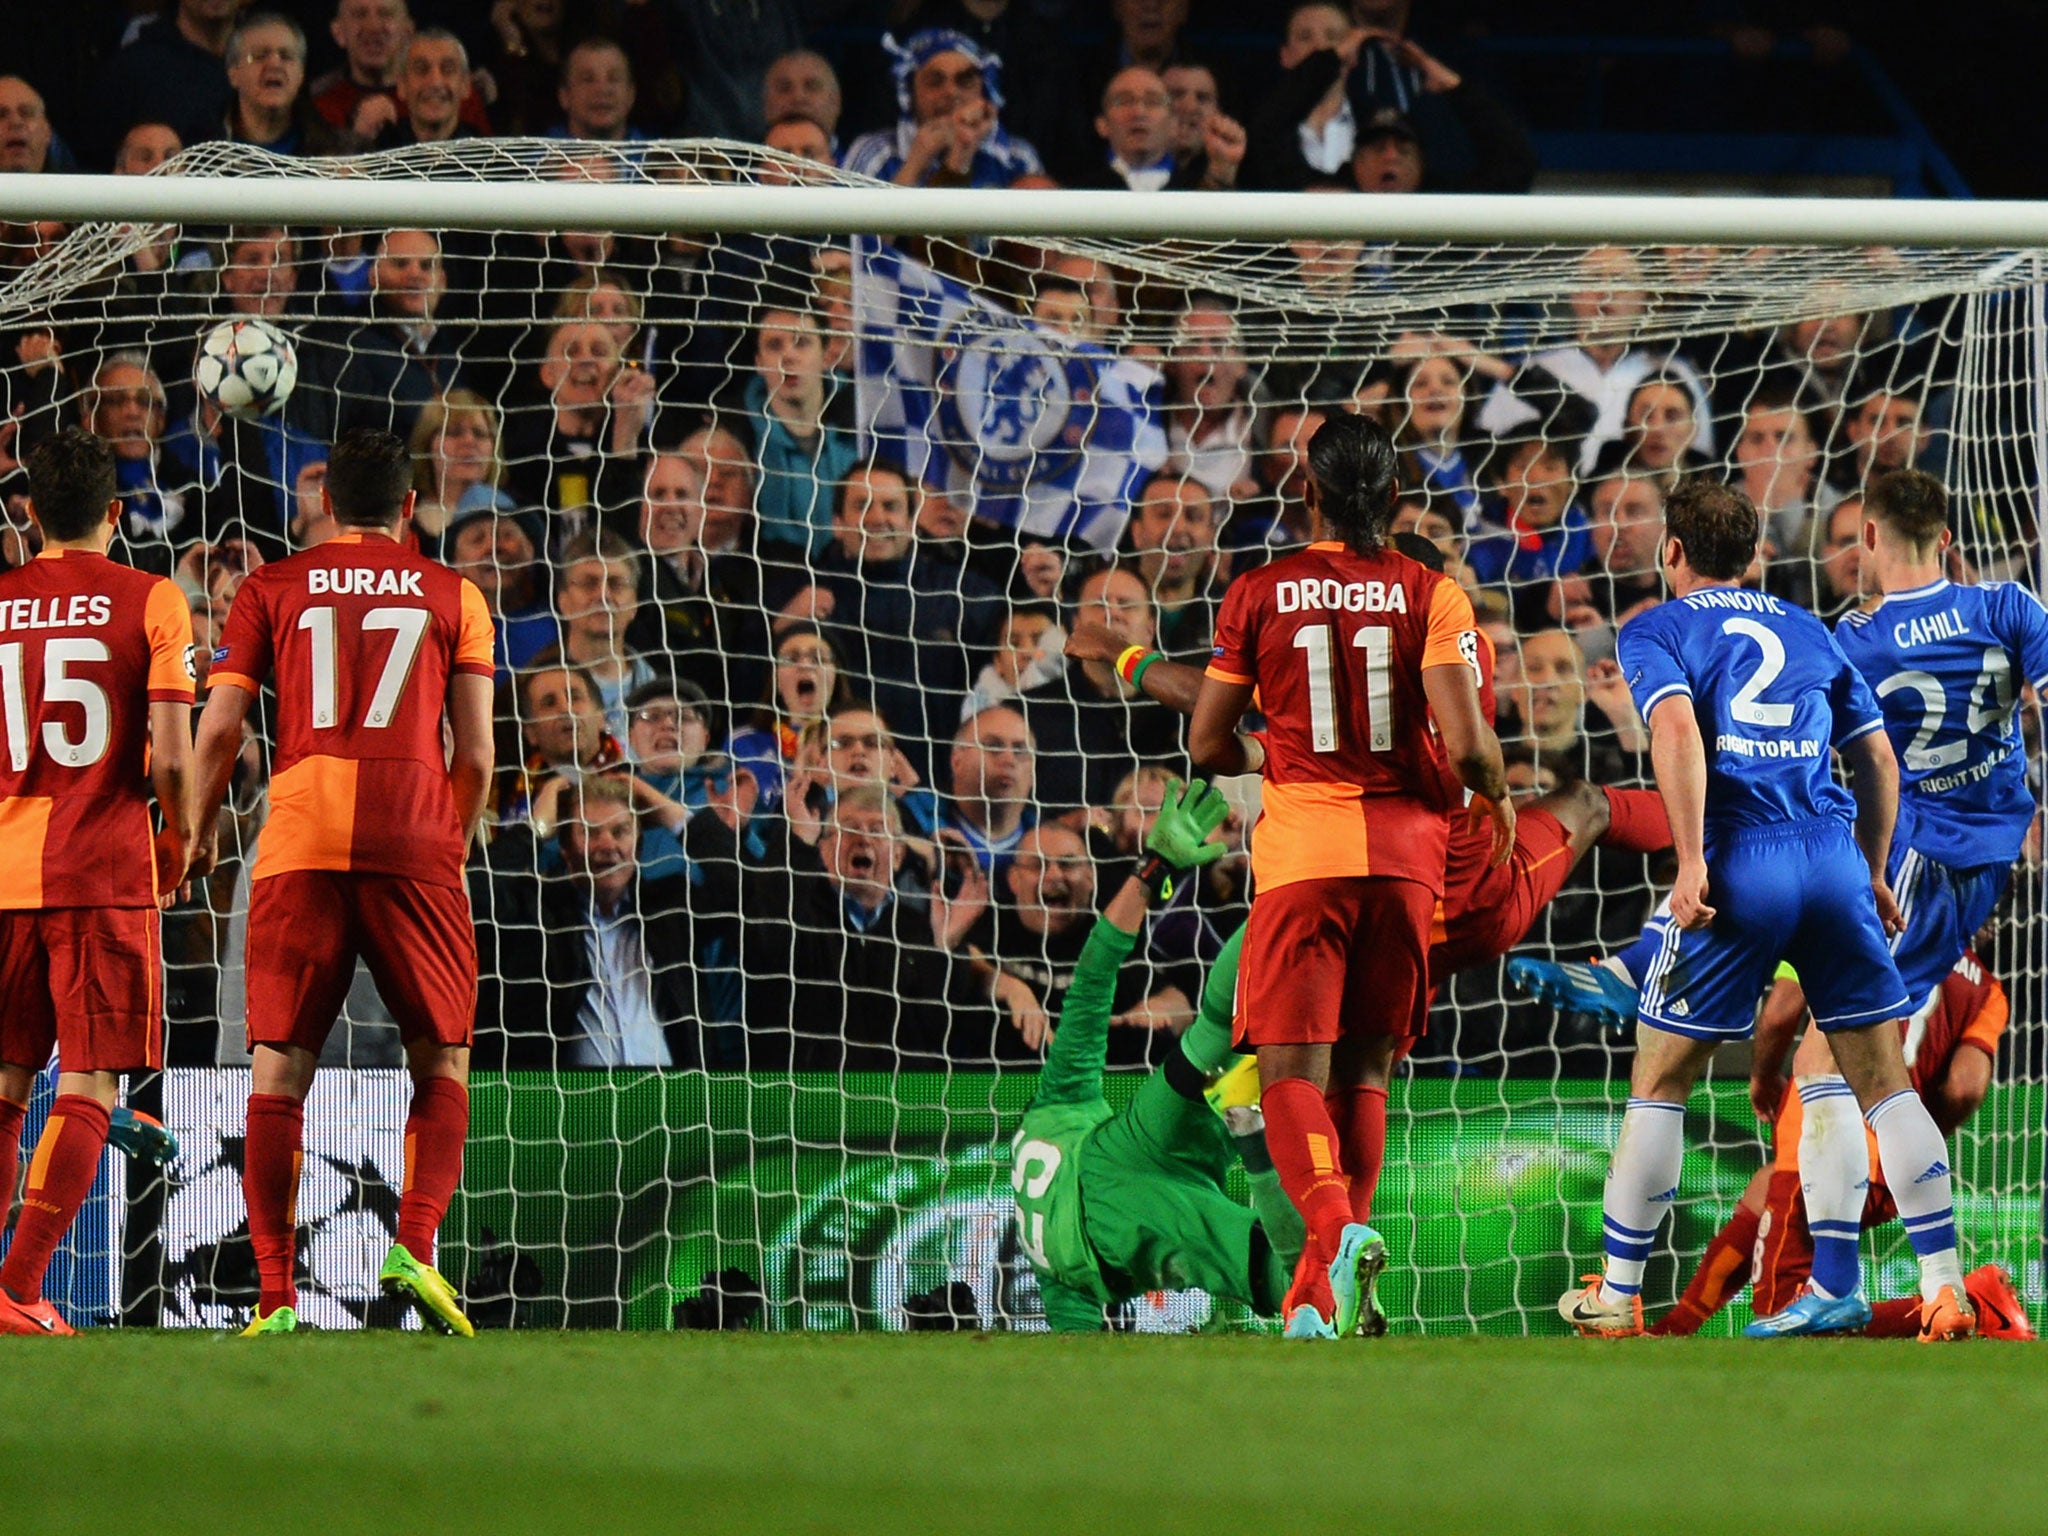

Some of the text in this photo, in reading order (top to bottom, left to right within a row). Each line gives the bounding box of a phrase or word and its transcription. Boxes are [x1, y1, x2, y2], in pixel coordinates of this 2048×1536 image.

[308, 568, 424, 597] BURAK
[1276, 578, 1407, 615] DROGBA
[0, 595, 112, 632] TELLES
[1683, 591, 1787, 616] IVANOVIC
[1893, 608, 1970, 649] CAHILL
[298, 606, 433, 729] 17
[1722, 617, 1796, 727] 2
[0, 637, 111, 772] 15
[1293, 624, 1393, 752] 11
[1875, 646, 2013, 771] 24
[1716, 733, 1819, 759] RIGHT TO PLAY
[1919, 770, 1968, 793] RIGHT
[1969, 761, 1990, 782] TO
